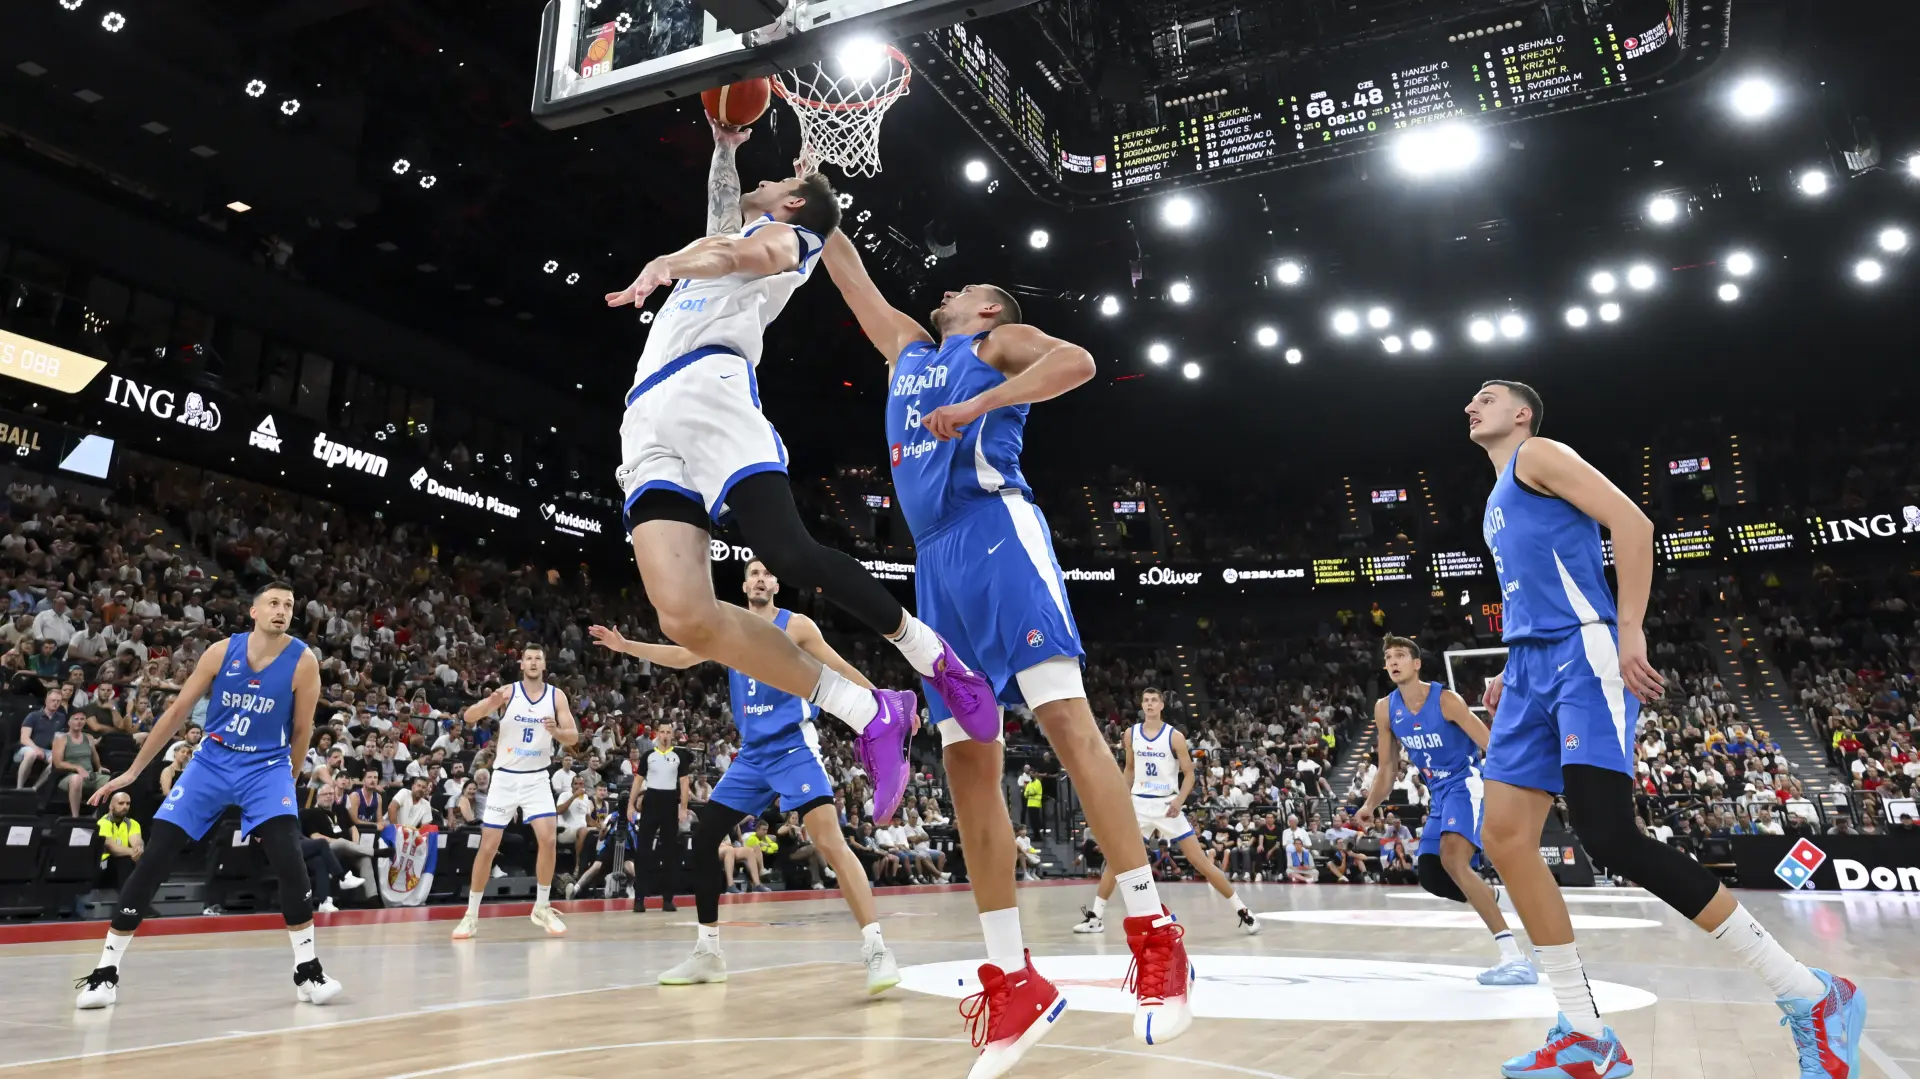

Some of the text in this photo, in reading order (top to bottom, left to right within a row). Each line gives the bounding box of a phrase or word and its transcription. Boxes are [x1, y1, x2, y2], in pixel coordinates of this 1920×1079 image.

[1639, 21, 1664, 40] TURKISH
[1641, 28, 1666, 45] AIRLINES
[1518, 37, 1555, 52] SEHNAL
[1626, 33, 1667, 59] SUPERCUP
[1504, 56, 1515, 65] 27
[1521, 48, 1554, 61] KREJCI
[583, 61, 610, 79] DBB
[1401, 63, 1439, 78] HANZLIK
[1506, 66, 1519, 74] 31
[1523, 60, 1544, 71] KRIZ
[1404, 75, 1429, 88] ZIDEK
[1508, 76, 1520, 84] 32
[1525, 68, 1556, 81] BALINT
[1510, 85, 1523, 94] 71
[1527, 75, 1571, 90] SVOBODA
[1357, 80, 1374, 90] CZE
[1395, 91, 1401, 99] 7
[1405, 82, 1441, 97] HRUBAN
[1306, 88, 1383, 118] 68 48
[1310, 91, 1327, 100] SRB
[1391, 101, 1403, 110] 11
[1407, 93, 1441, 106] KEJVAL
[1512, 95, 1525, 104] 77
[1530, 85, 1570, 101] KYZLINK
[1216, 108, 1240, 119] JOKIC
[1328, 110, 1367, 127] 08:10
[1393, 111, 1406, 119] 14
[1409, 103, 1444, 116] HUSTAK
[1411, 111, 1453, 126] PETERKA
[1204, 123, 1215, 131] 23
[1218, 115, 1252, 128] GUDURIC
[1322, 121, 1376, 141] 2 FOULS 0
[1122, 126, 1160, 140] PETRUSEV
[1206, 142, 1217, 150] 27
[1220, 132, 1263, 147] DAVIDOVAC
[1219, 127, 1241, 138] JOVIC
[1123, 139, 1144, 150] JOVIC
[1123, 143, 1169, 158] BOGDANOVIC
[1208, 151, 1218, 159] 30
[1222, 141, 1267, 156] AVRAMOVIC
[1124, 152, 1170, 167] MARINKOVIC
[1209, 160, 1220, 168] 33
[1223, 151, 1264, 165] MILUTINOV
[1112, 171, 1122, 179] 11
[1124, 163, 1161, 176] VUKCEVIC
[1112, 180, 1123, 188] 13
[1126, 174, 1153, 186] DOBRIC
[105, 374, 175, 419] ING
[905, 400, 921, 430] 15
[249, 430, 283, 453] PEAK
[903, 440, 938, 459] triglav
[312, 432, 388, 477] tipwin
[427, 478, 518, 518] Domino's Pizza
[555, 510, 601, 533] vividabkk
[1826, 513, 1897, 542] ING
[874, 560, 916, 573] Western
[1061, 567, 1115, 581] orthomol
[1139, 566, 1202, 585] s.Oliver
[748, 679, 756, 696] 3
[221, 691, 275, 714] SRBIJA
[747, 703, 774, 716] triglav
[225, 713, 251, 736] 30
[522, 727, 534, 743] 15
[1137, 750, 1166, 758] ČESKO
[1145, 762, 1158, 776] 32
